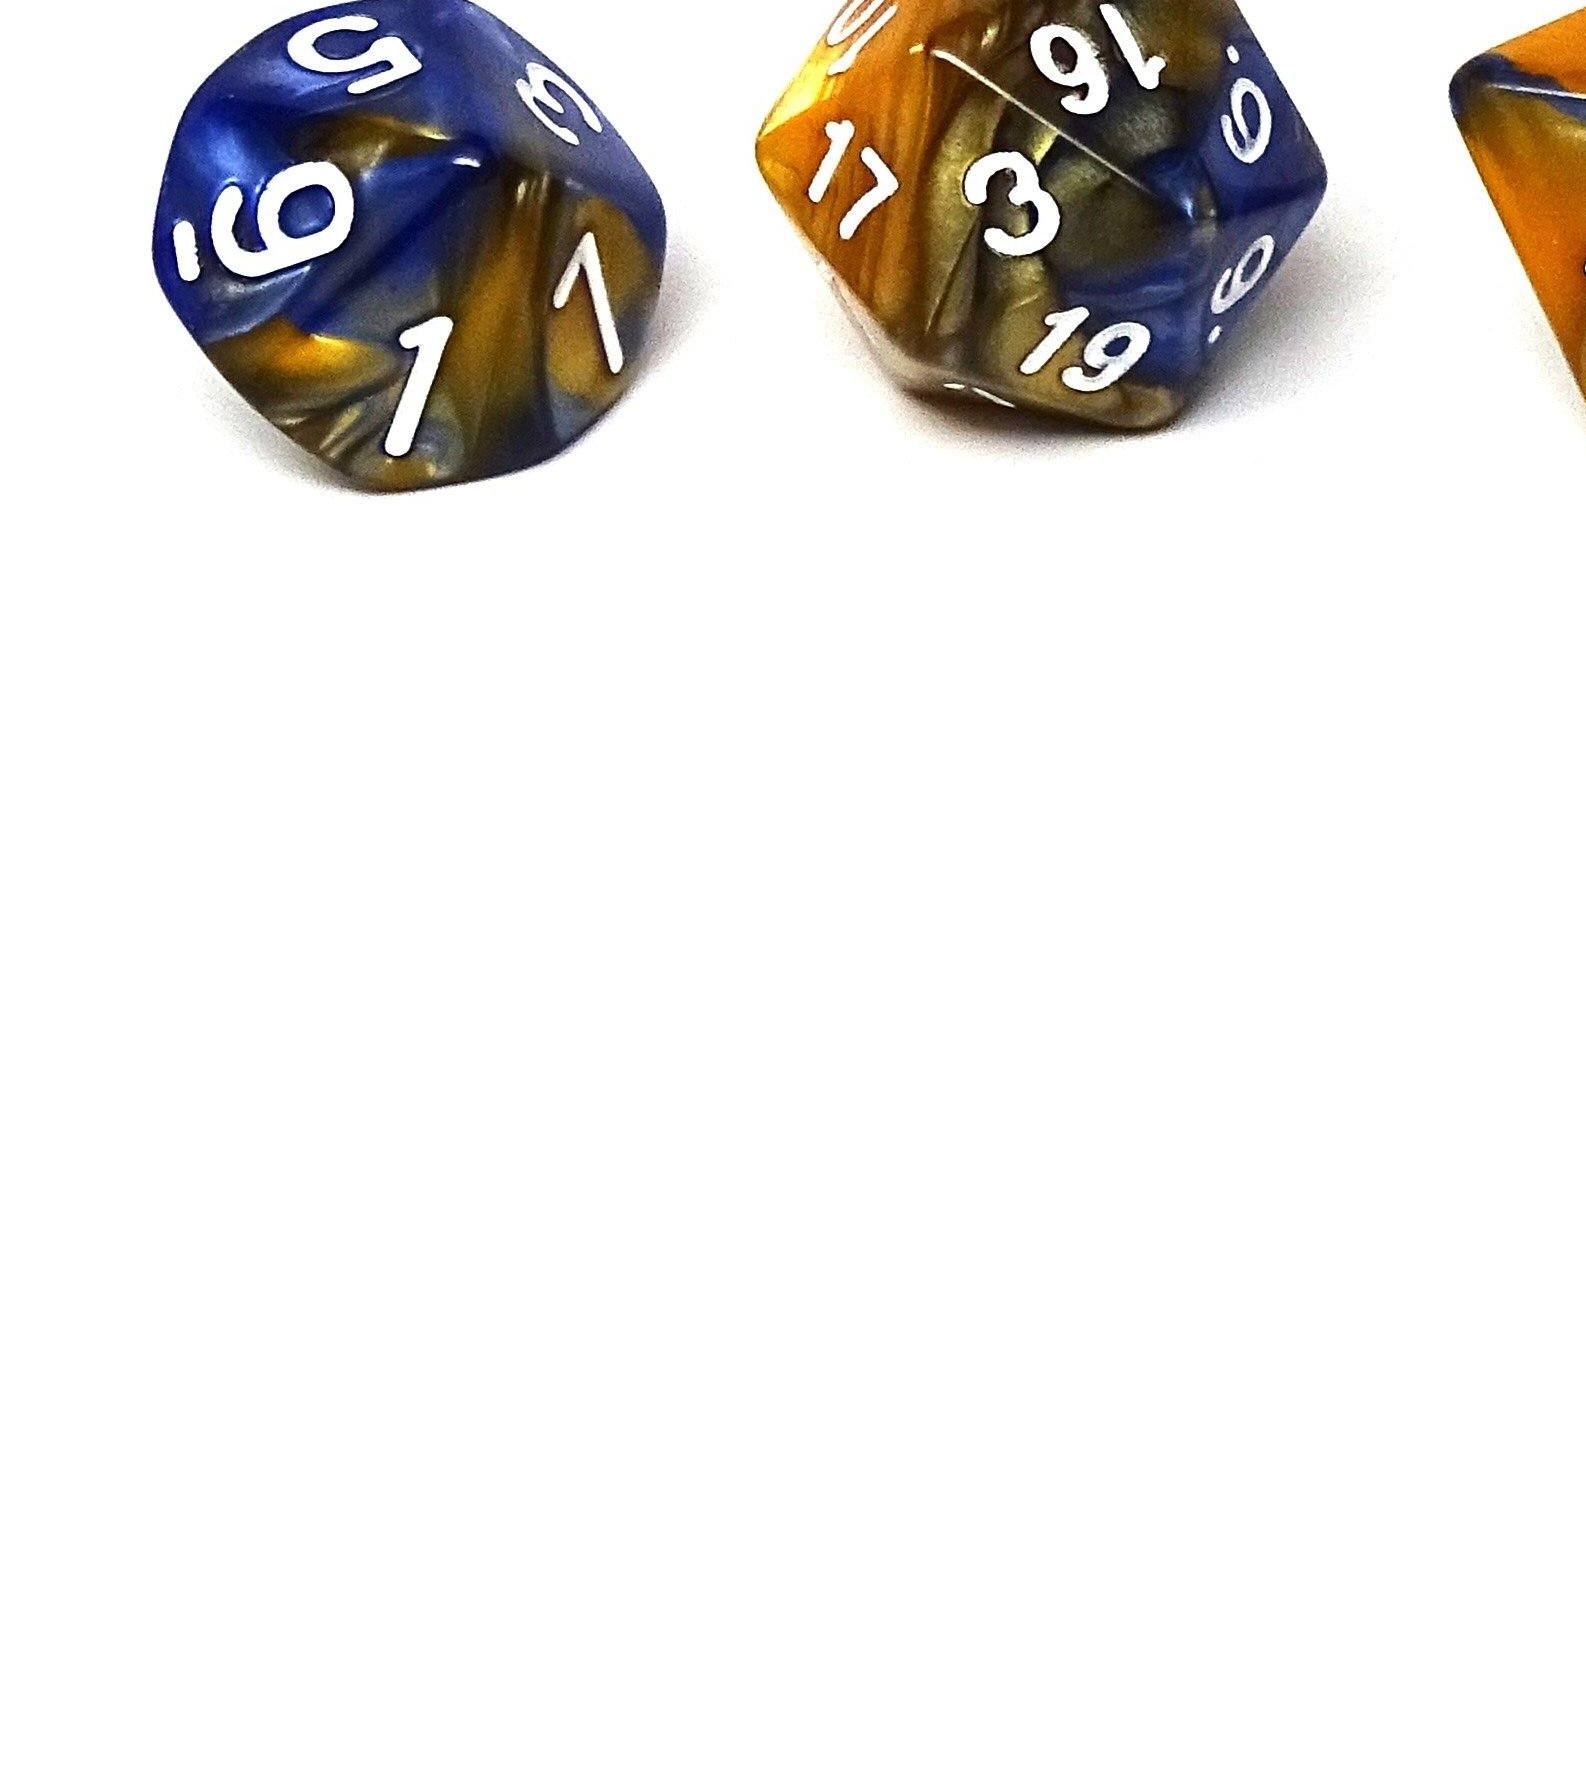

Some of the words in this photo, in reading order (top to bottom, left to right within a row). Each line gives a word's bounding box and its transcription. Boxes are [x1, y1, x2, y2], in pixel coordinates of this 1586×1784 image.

[287, 15, 422, 95] 5
[515, 61, 603, 146] 3
[1030, 3, 1167, 115] 16
[808, 120, 899, 240] 17
[963, 151, 1061, 256] 3
[384, 316, 454, 457] 1
[1020, 307, 1151, 392] 19
